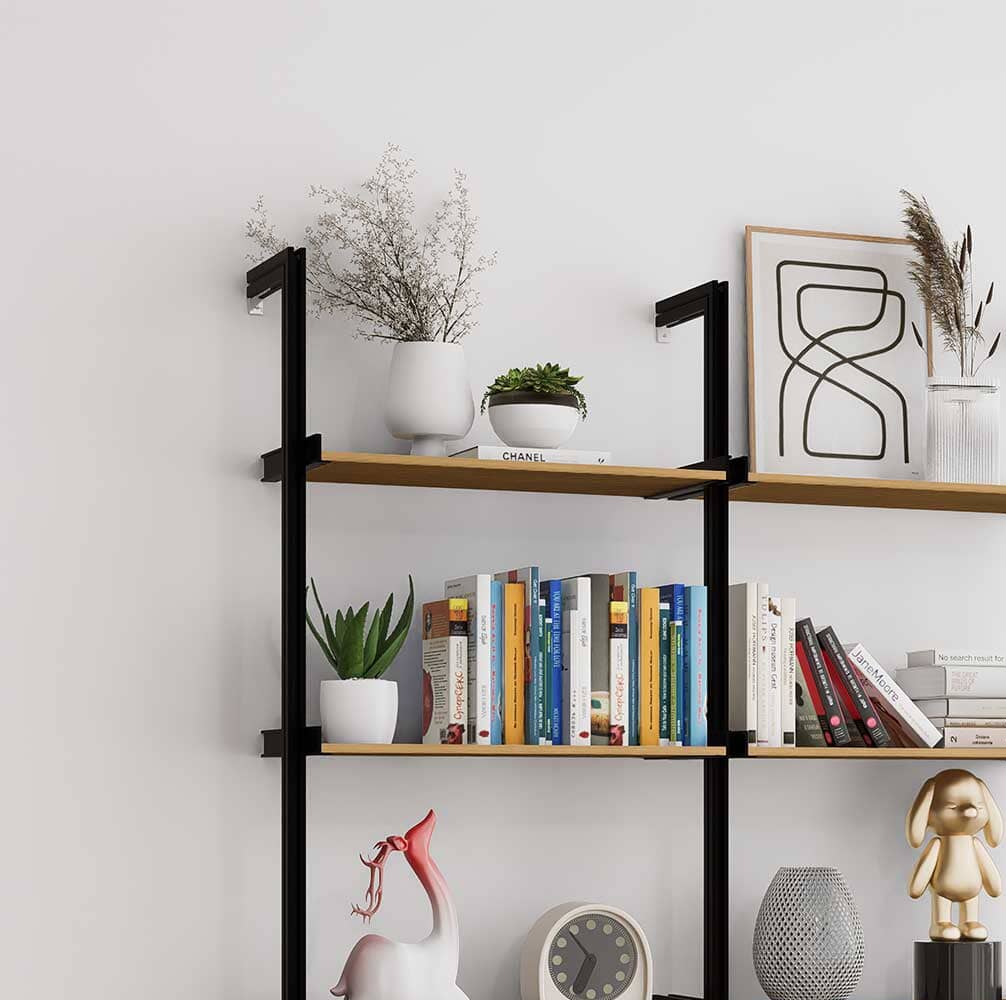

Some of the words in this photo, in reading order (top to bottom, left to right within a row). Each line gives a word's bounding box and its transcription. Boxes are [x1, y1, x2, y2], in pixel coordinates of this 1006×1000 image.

[502, 451, 546, 463] CHANEL
[769, 622, 778, 646] Design
[938, 653, 949, 661] No
[950, 654, 973, 662] search
[974, 654, 994, 662] result
[995, 654, 1005, 662] for
